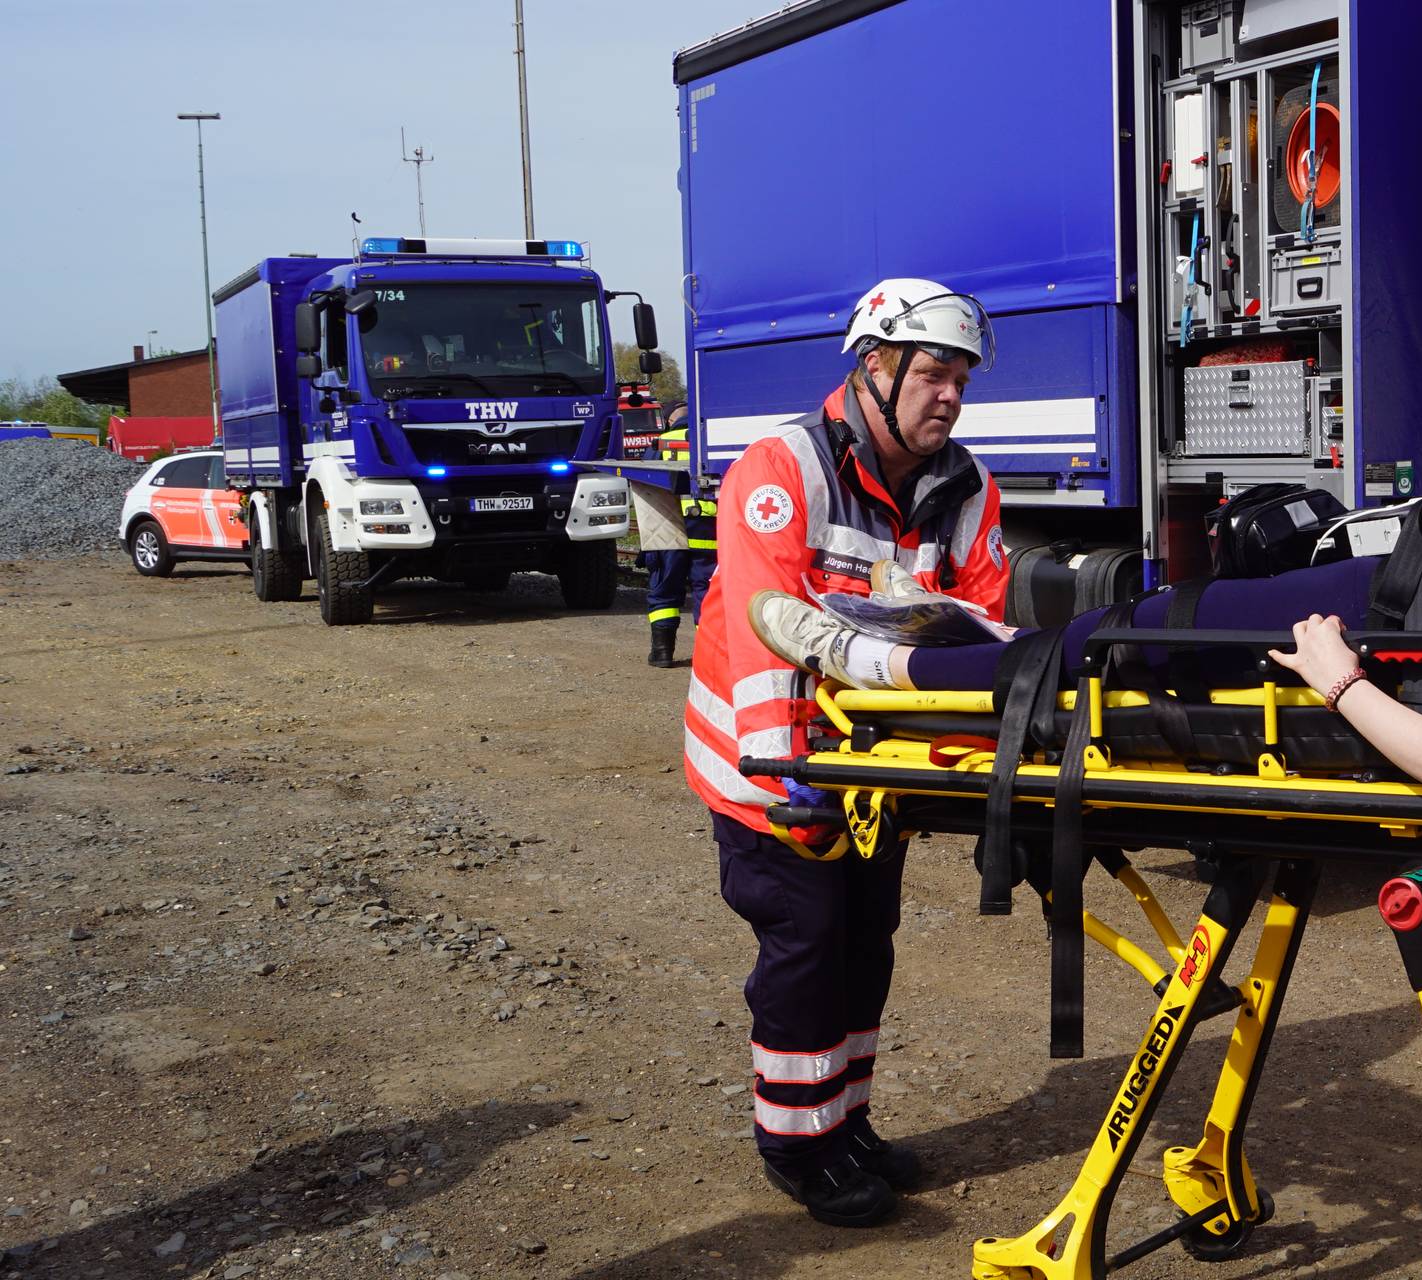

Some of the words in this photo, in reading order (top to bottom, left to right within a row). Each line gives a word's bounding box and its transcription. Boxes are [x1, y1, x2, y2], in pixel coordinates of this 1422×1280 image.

[465, 402, 518, 420] THW
[469, 443, 526, 454] MAN
[477, 499, 495, 509] THW
[502, 497, 531, 509] 92517
[752, 489, 789, 508] DEUTSCHES
[764, 513, 786, 528] KREUZ
[825, 556, 853, 569] Jürgen
